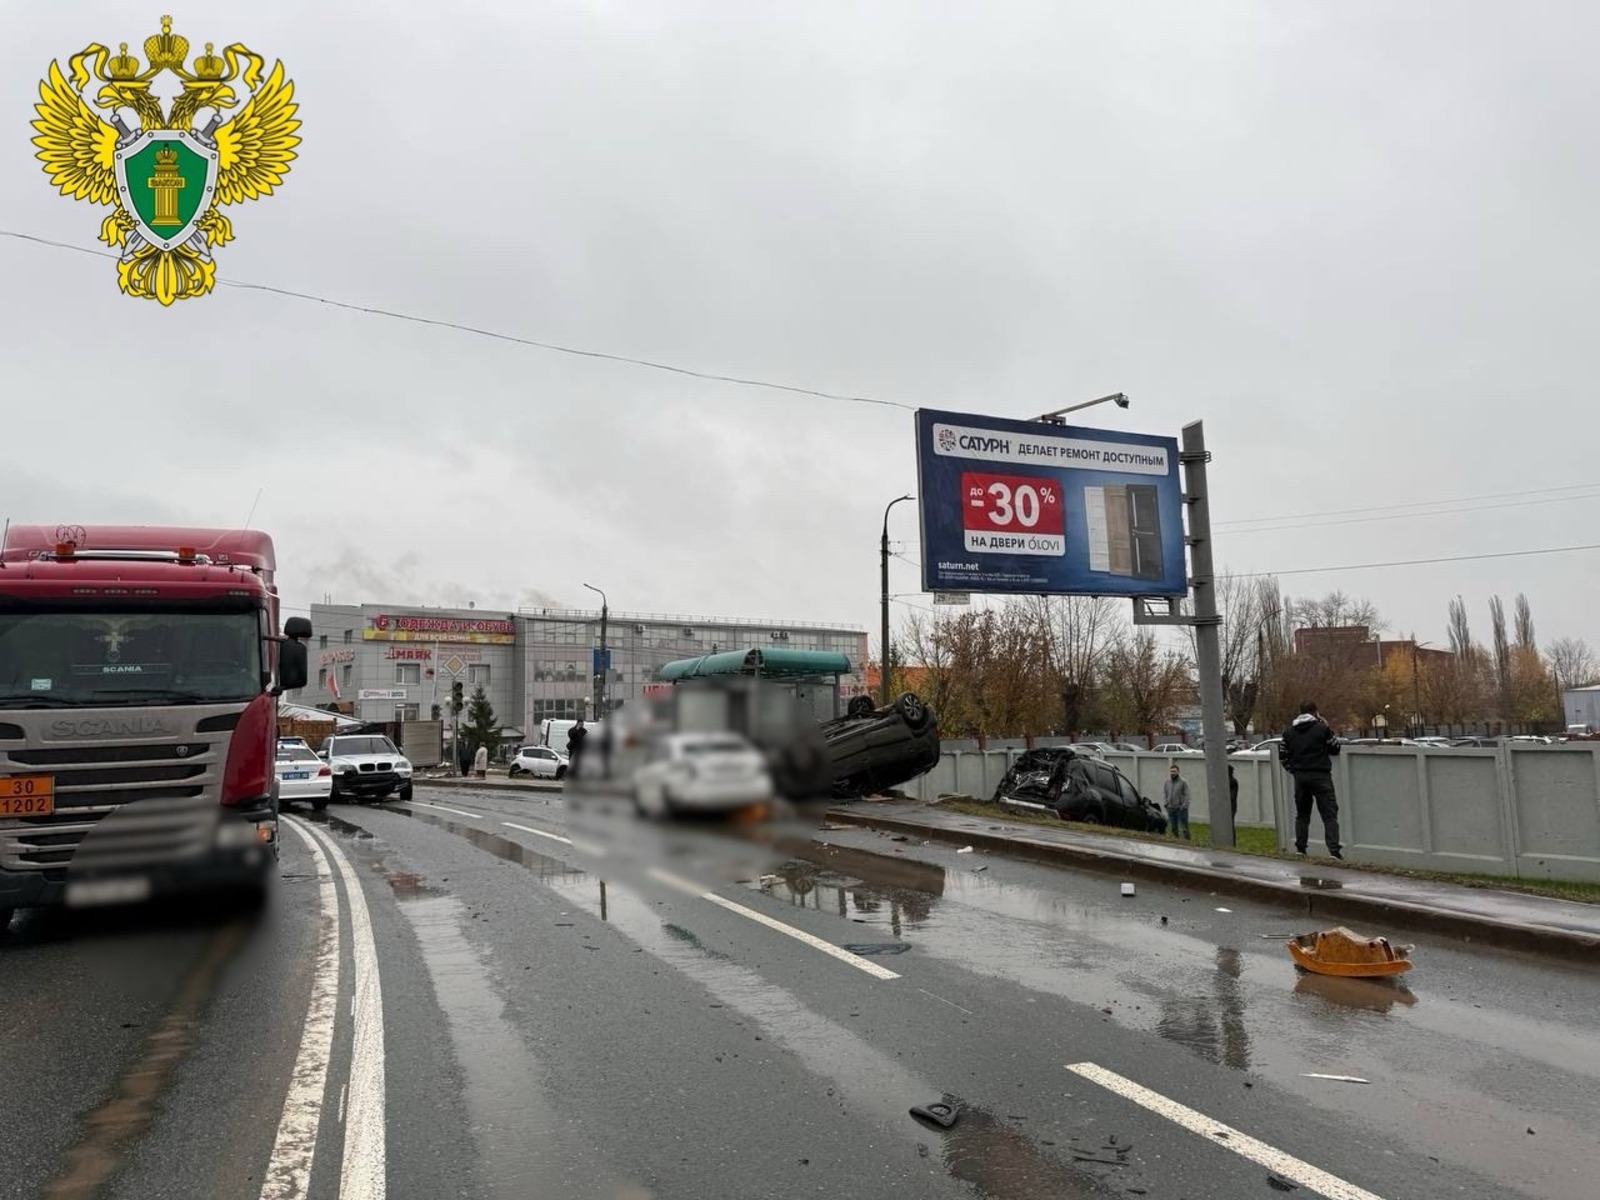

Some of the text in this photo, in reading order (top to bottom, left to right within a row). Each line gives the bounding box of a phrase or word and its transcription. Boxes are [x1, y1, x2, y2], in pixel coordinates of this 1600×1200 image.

[959, 435, 1164, 466] САТУРН ДЕЛАЕТ РЕМОНТ ДОСТУПНЫМ
[971, 536, 987, 547] НА
[990, 537, 1025, 549] ДВЕРИ
[938, 561, 979, 571] saturn.net
[399, 617, 460, 632] ОДЕЖДА
[475, 621, 514, 633] ОБУВЬ
[102, 665, 143, 673] SCANIA
[51, 717, 166, 738] SCANIA
[13, 779, 34, 794] 30
[2, 798, 46, 814] 1202
